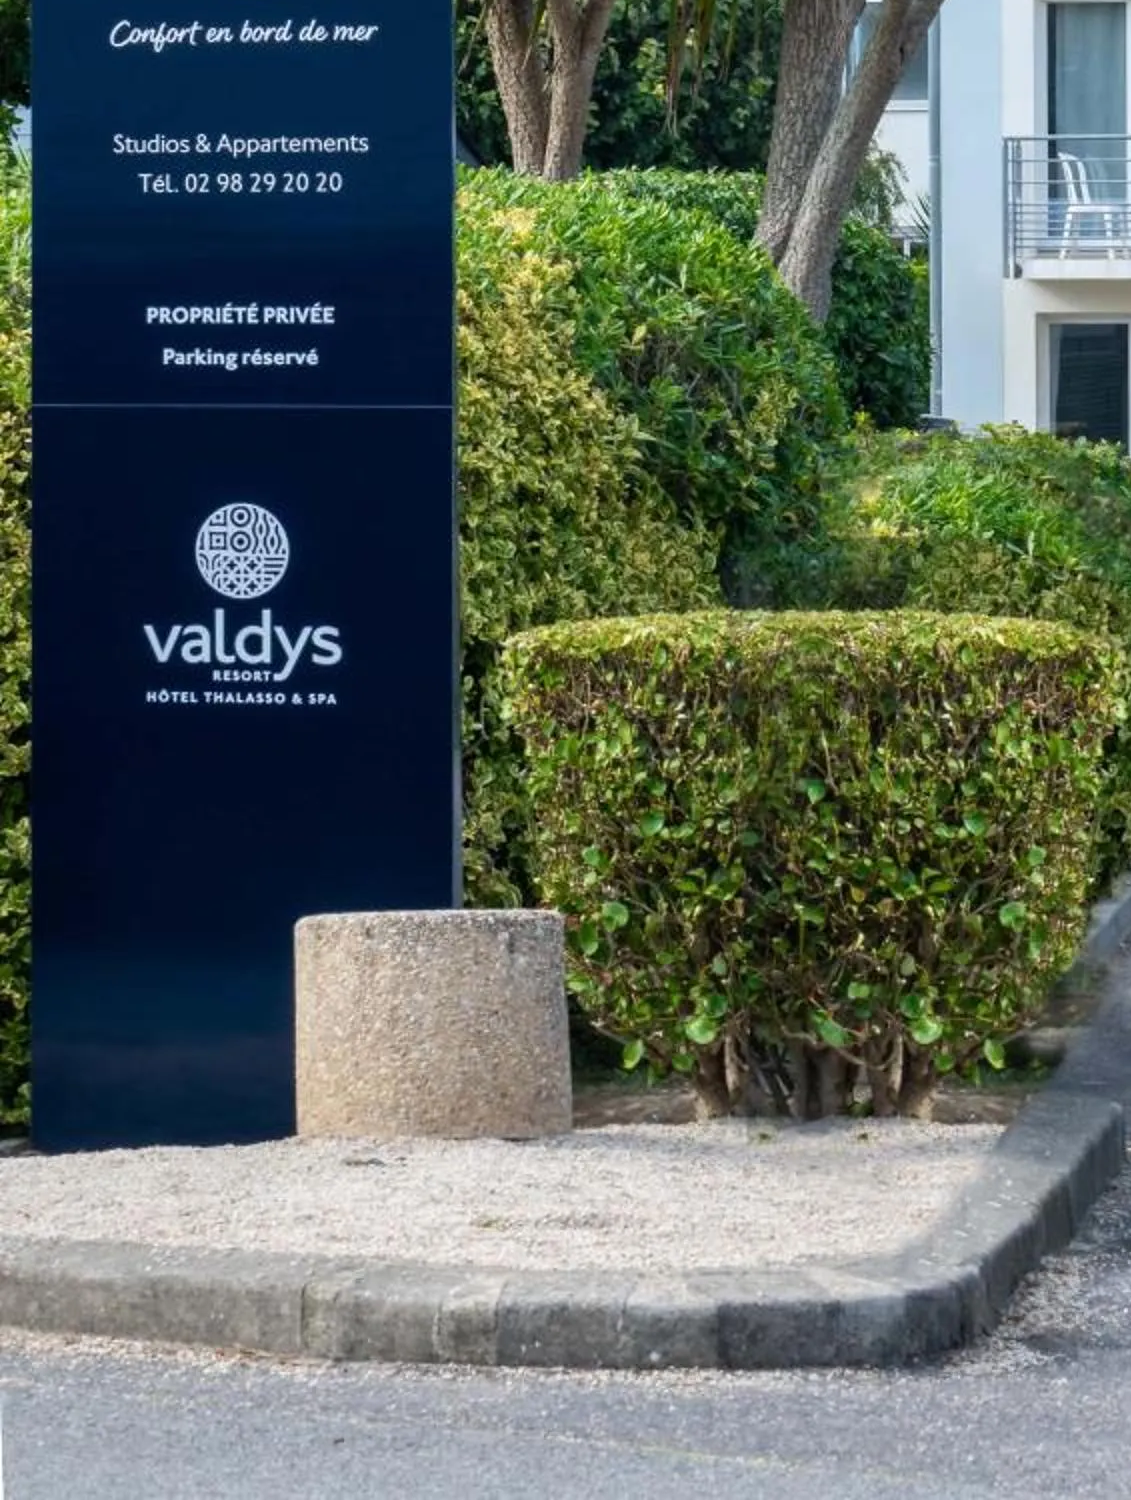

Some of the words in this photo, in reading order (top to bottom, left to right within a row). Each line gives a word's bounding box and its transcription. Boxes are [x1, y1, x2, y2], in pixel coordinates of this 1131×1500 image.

[109, 19, 203, 53] Confort
[205, 26, 234, 43] en
[239, 19, 294, 43] bord
[298, 19, 329, 42] de
[332, 25, 379, 42] mer
[112, 133, 191, 154] Studios
[195, 134, 212, 154] &
[215, 133, 369, 159] Appartements
[137, 172, 179, 194] Tél.
[184, 172, 210, 193] 02
[216, 172, 243, 193] 98
[249, 172, 277, 193] 29
[282, 172, 310, 193] 20
[315, 171, 343, 193] 20
[146, 302, 260, 325] PROPRIÉTÉ
[263, 302, 336, 325] PRIVÉE
[162, 347, 239, 372] Parking
[241, 347, 319, 366] réservé
[143, 607, 343, 682] valdys
[212, 669, 272, 682] RESORT
[145, 688, 199, 704] HÔTEL
[203, 691, 286, 705] THALASSO
[291, 692, 303, 705] &
[308, 692, 337, 705] SPA
